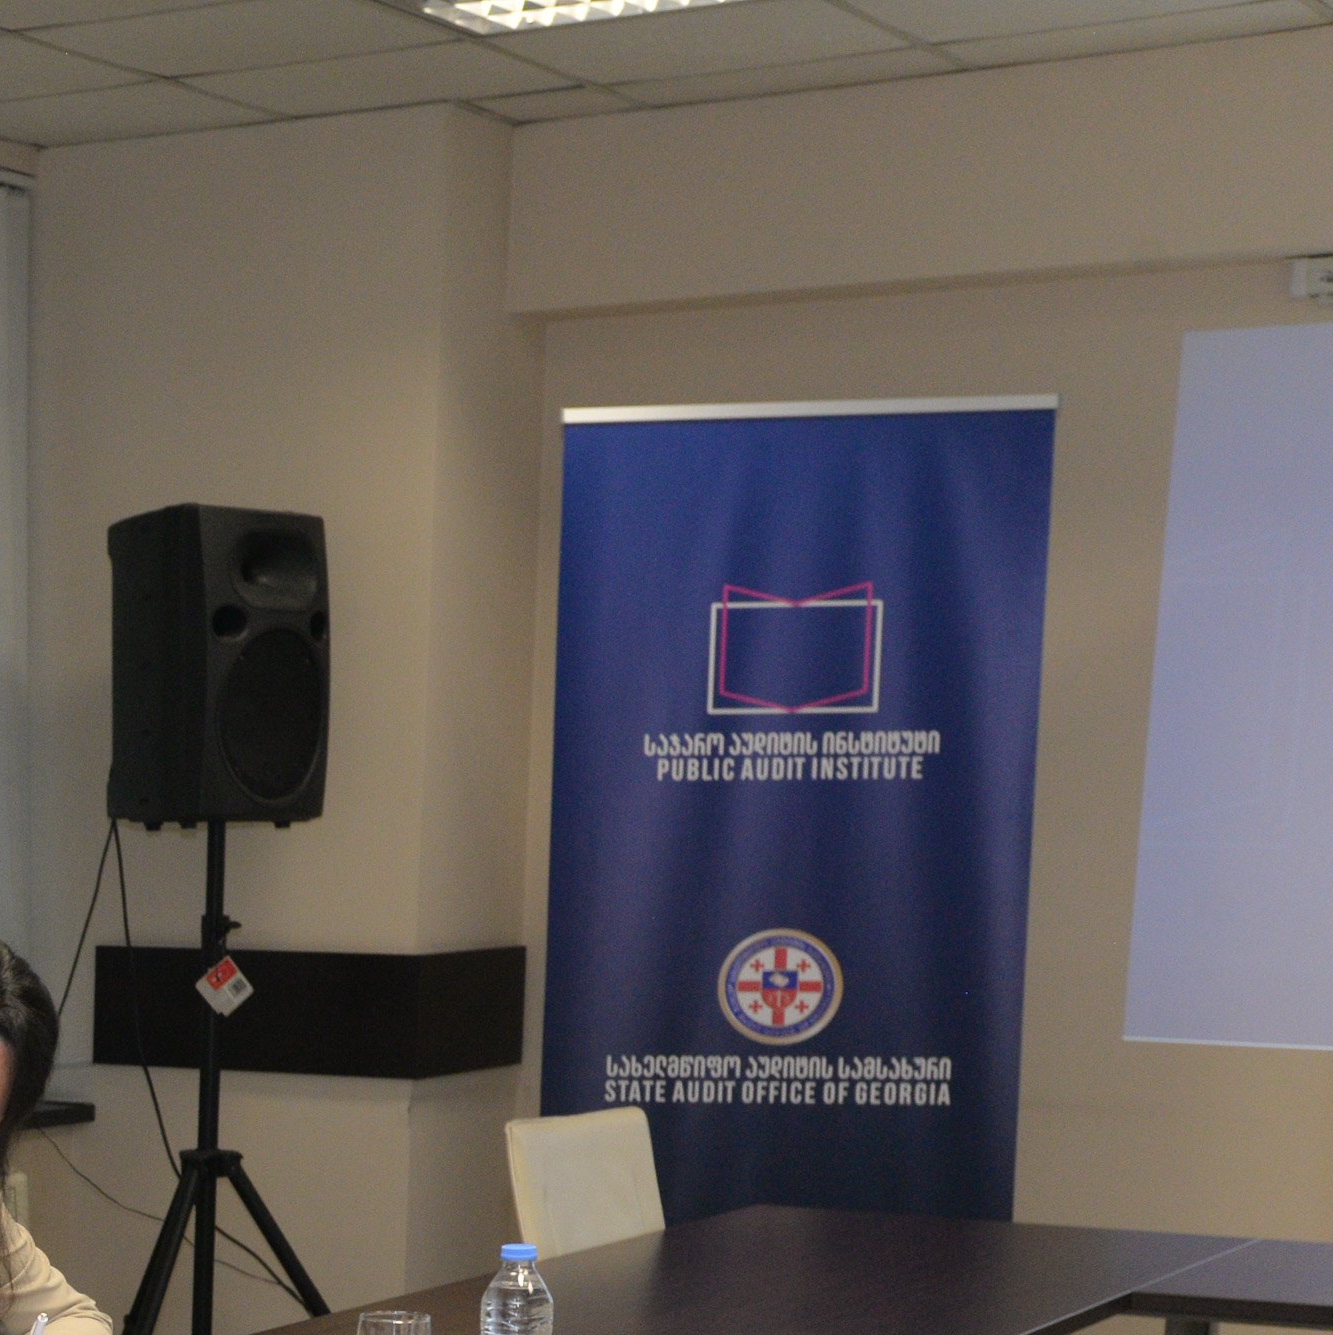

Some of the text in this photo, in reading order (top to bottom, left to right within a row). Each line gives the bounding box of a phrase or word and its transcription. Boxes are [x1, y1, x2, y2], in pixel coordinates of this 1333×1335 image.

[644, 730, 941, 756] საჯარო აუდიტის ინსტიტუტი
[657, 755, 924, 781] PUBLIC AUDIT INSTITUTE
[606, 1055, 952, 1081] სახელმწიფო აუდიტის სამსახური
[604, 1080, 951, 1106] STATE AUDIT OFFICE OF GEORGIA
